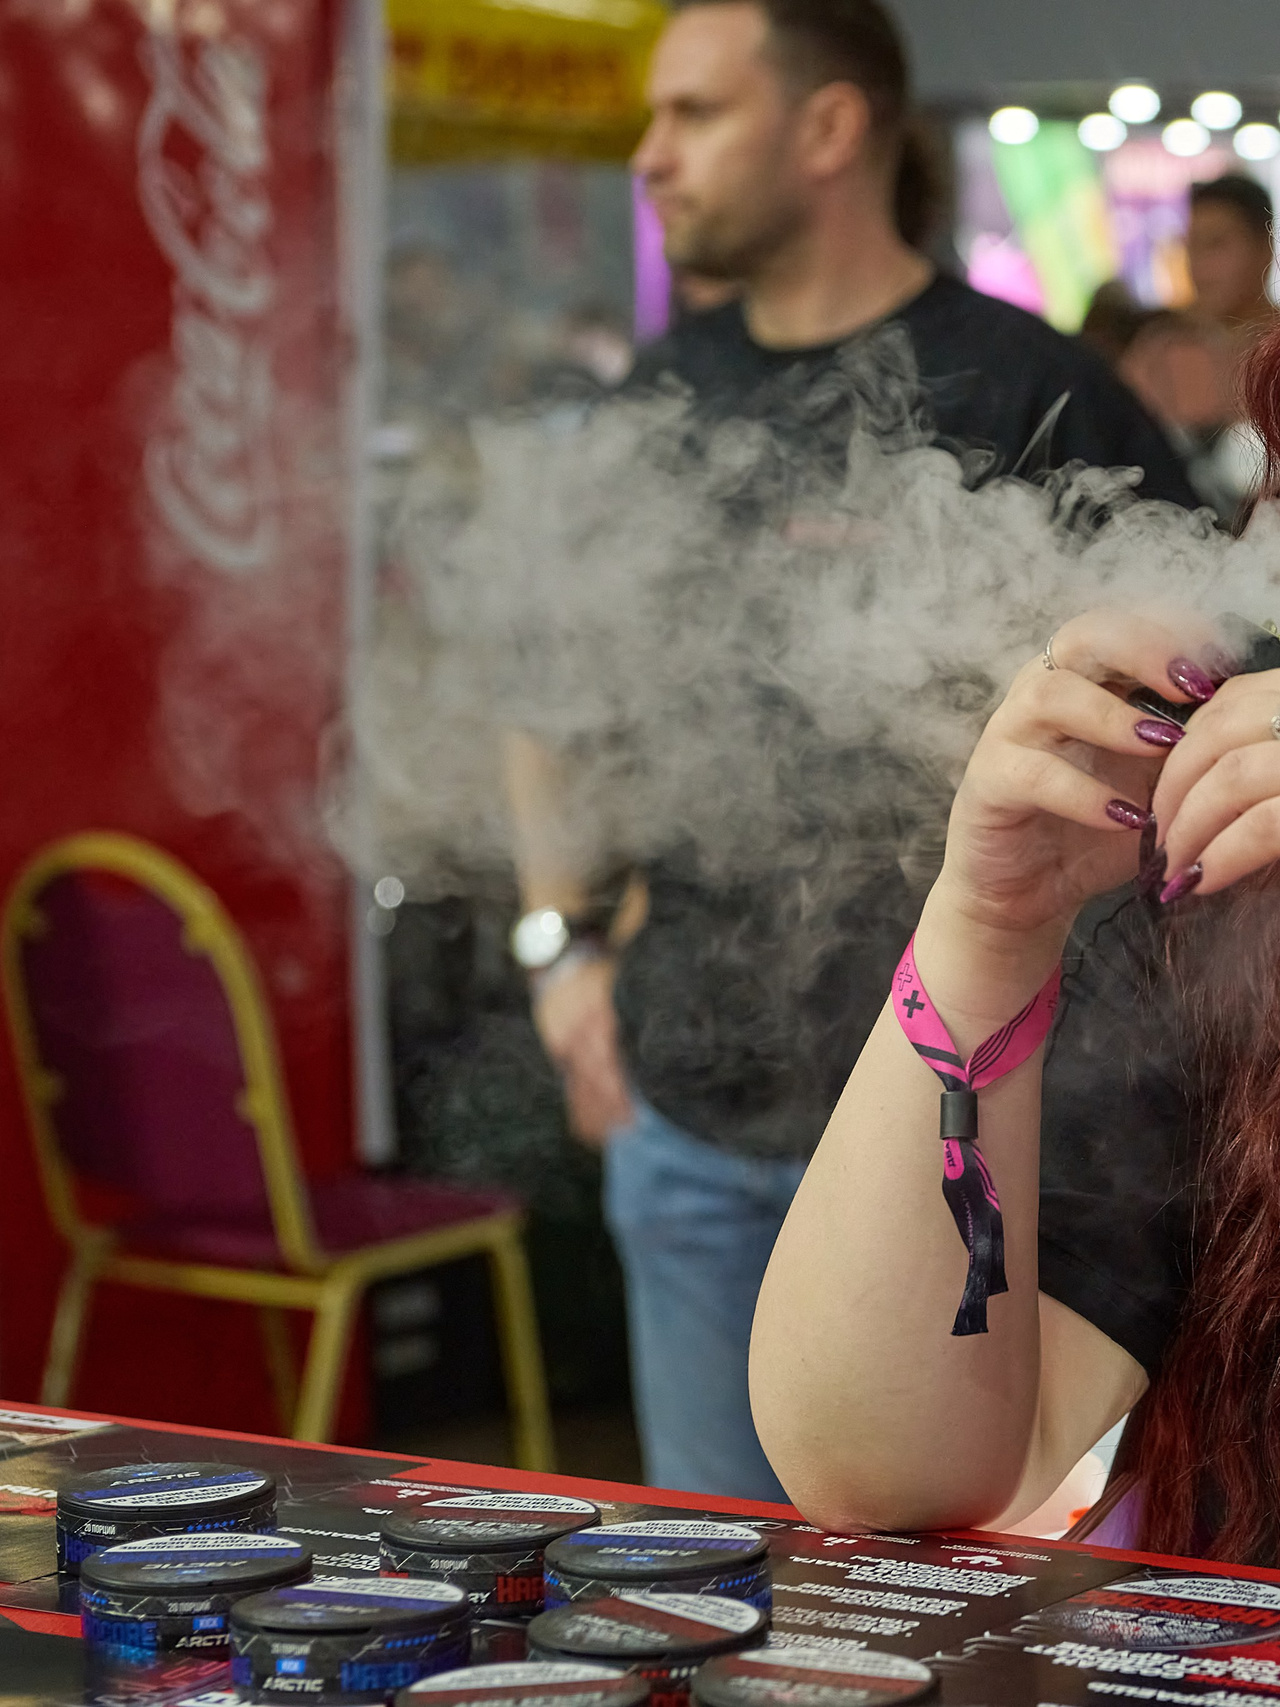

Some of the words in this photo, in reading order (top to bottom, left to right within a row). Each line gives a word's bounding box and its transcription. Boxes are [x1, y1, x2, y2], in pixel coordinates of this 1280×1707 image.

[110, 1471, 201, 1486] ARCTIC
[84, 1524, 92, 1532] 20
[91, 1524, 116, 1536] ПОРЦИЙ
[596, 1547, 700, 1556] ARCTIC
[141, 1560, 248, 1570] ARCTIC
[430, 1559, 439, 1570] 20
[440, 1559, 468, 1571] ПОРЦИЙ
[849, 1555, 1036, 1581] АРОМАТИЗАТОРЫ
[468, 1592, 491, 1604] RY
[168, 1603, 179, 1612] 20
[175, 1634, 230, 1648] ARCTI
[262, 1677, 324, 1693] ARCTIC
